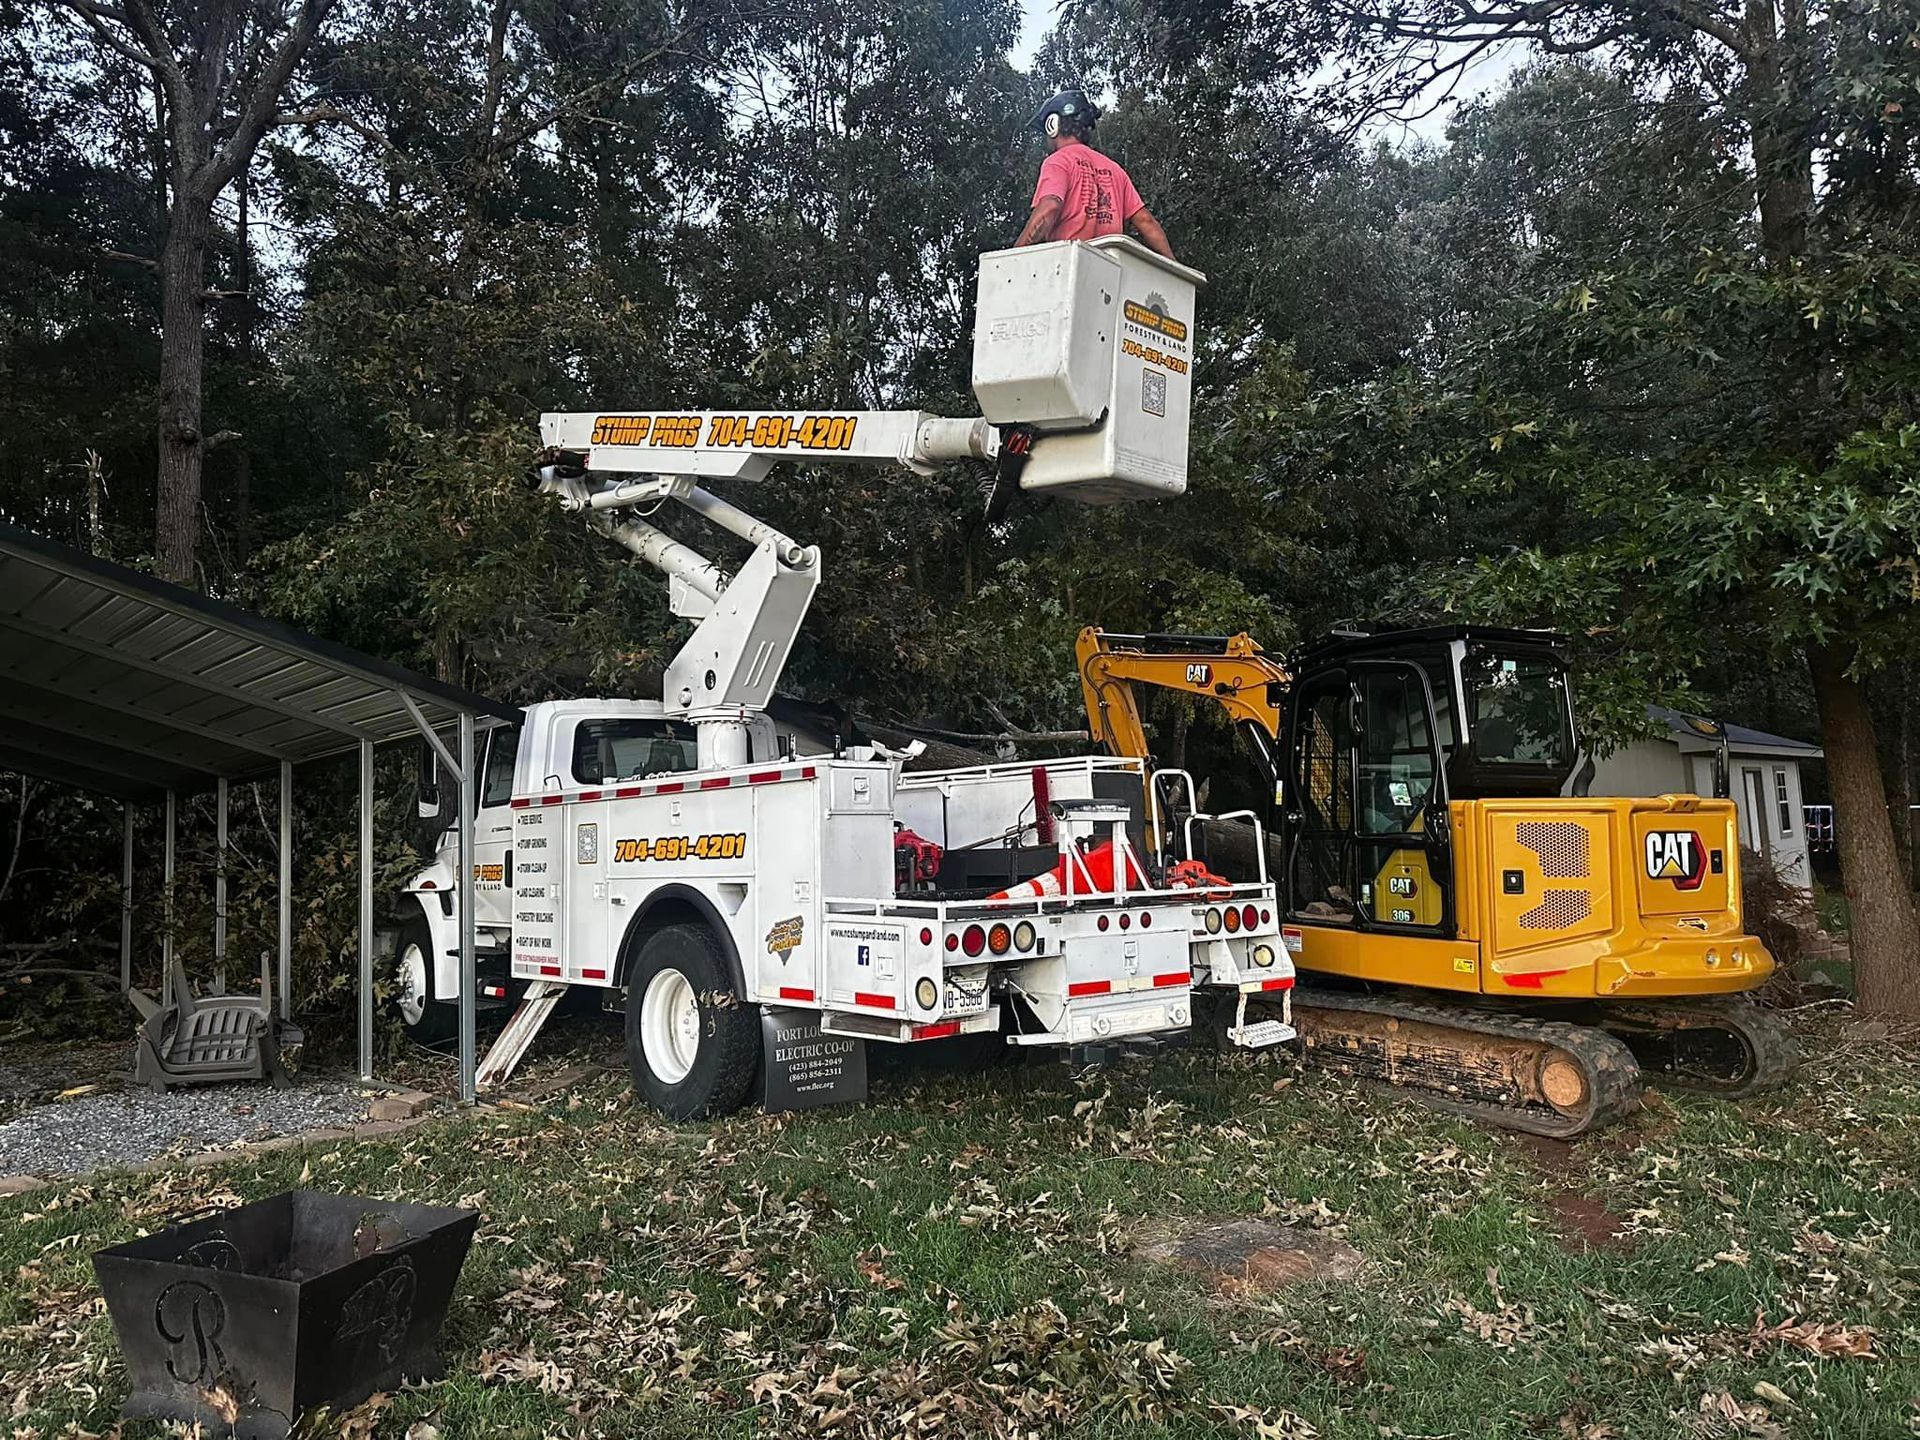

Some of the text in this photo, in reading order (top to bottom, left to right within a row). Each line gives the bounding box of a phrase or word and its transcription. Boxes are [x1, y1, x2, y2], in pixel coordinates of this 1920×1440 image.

[1126, 303, 1186, 339] STUMP PROS
[1124, 322, 1187, 353] FORESTRY & LAND
[1122, 338, 1188, 375] 704-691-4201
[591, 416, 858, 450] STUMP PROS 704-691-4201
[1186, 664, 1208, 683] CAT
[614, 832, 746, 862] 704-691-4201
[1646, 832, 1692, 878] CAT
[481, 864, 503, 881] PROS
[486, 883, 501, 891] LAND
[1389, 877, 1411, 894] CAT
[1391, 909, 1411, 922] 306
[776, 1027, 802, 1042] FORT
[775, 1040, 855, 1062] ELECTRIC CO-OP
[788, 1057, 843, 1073] (423) 884-2049
[808, 1067, 842, 1079] 856-2311
